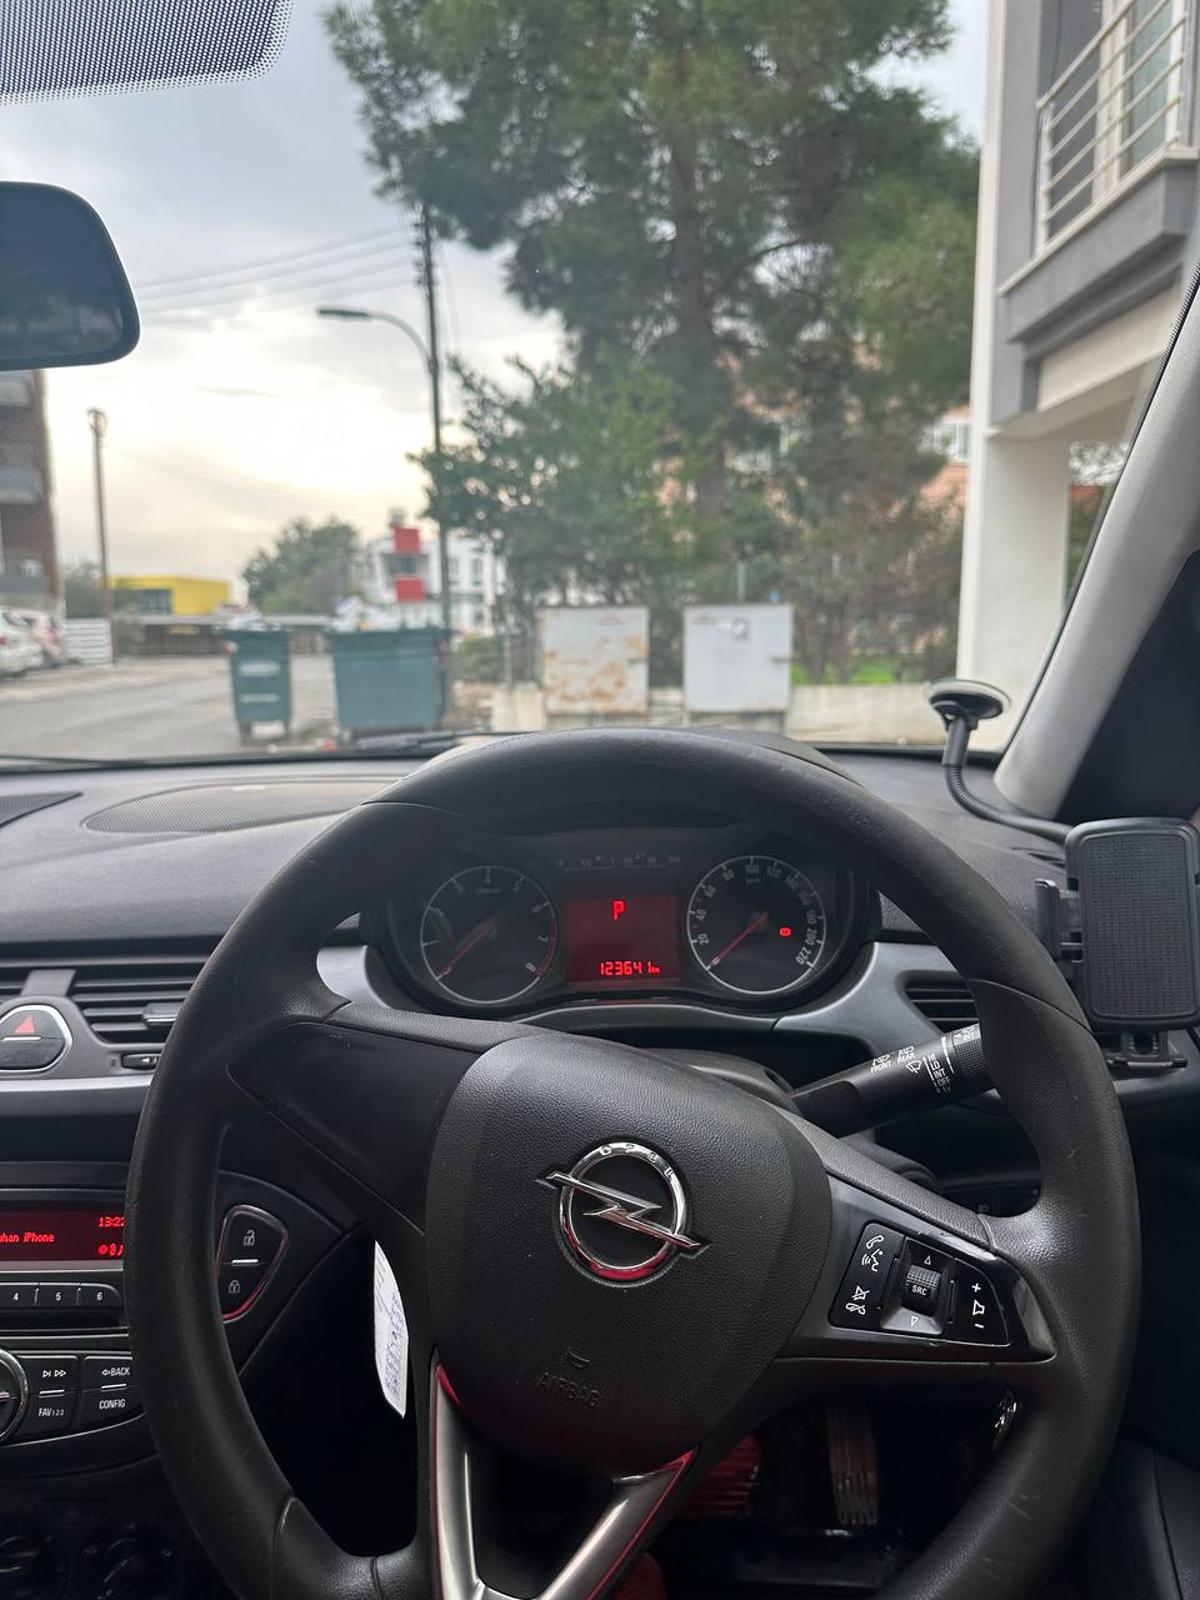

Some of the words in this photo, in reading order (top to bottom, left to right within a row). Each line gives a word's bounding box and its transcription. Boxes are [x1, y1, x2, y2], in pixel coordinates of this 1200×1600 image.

[612, 900, 625, 920] P
[930, 1060, 941, 1071] LO
[933, 1068, 946, 1080] INT
[600, 1143, 674, 1177] OPEL
[23, 1232, 55, 1242] iPhone
[911, 1284, 928, 1296] SRC
[13, 1292, 19, 1301] 4
[55, 1292, 61, 1301] 5
[97, 1291, 103, 1300] 6
[111, 1367, 130, 1376] BACK
[99, 1399, 126, 1409] CONFIG
